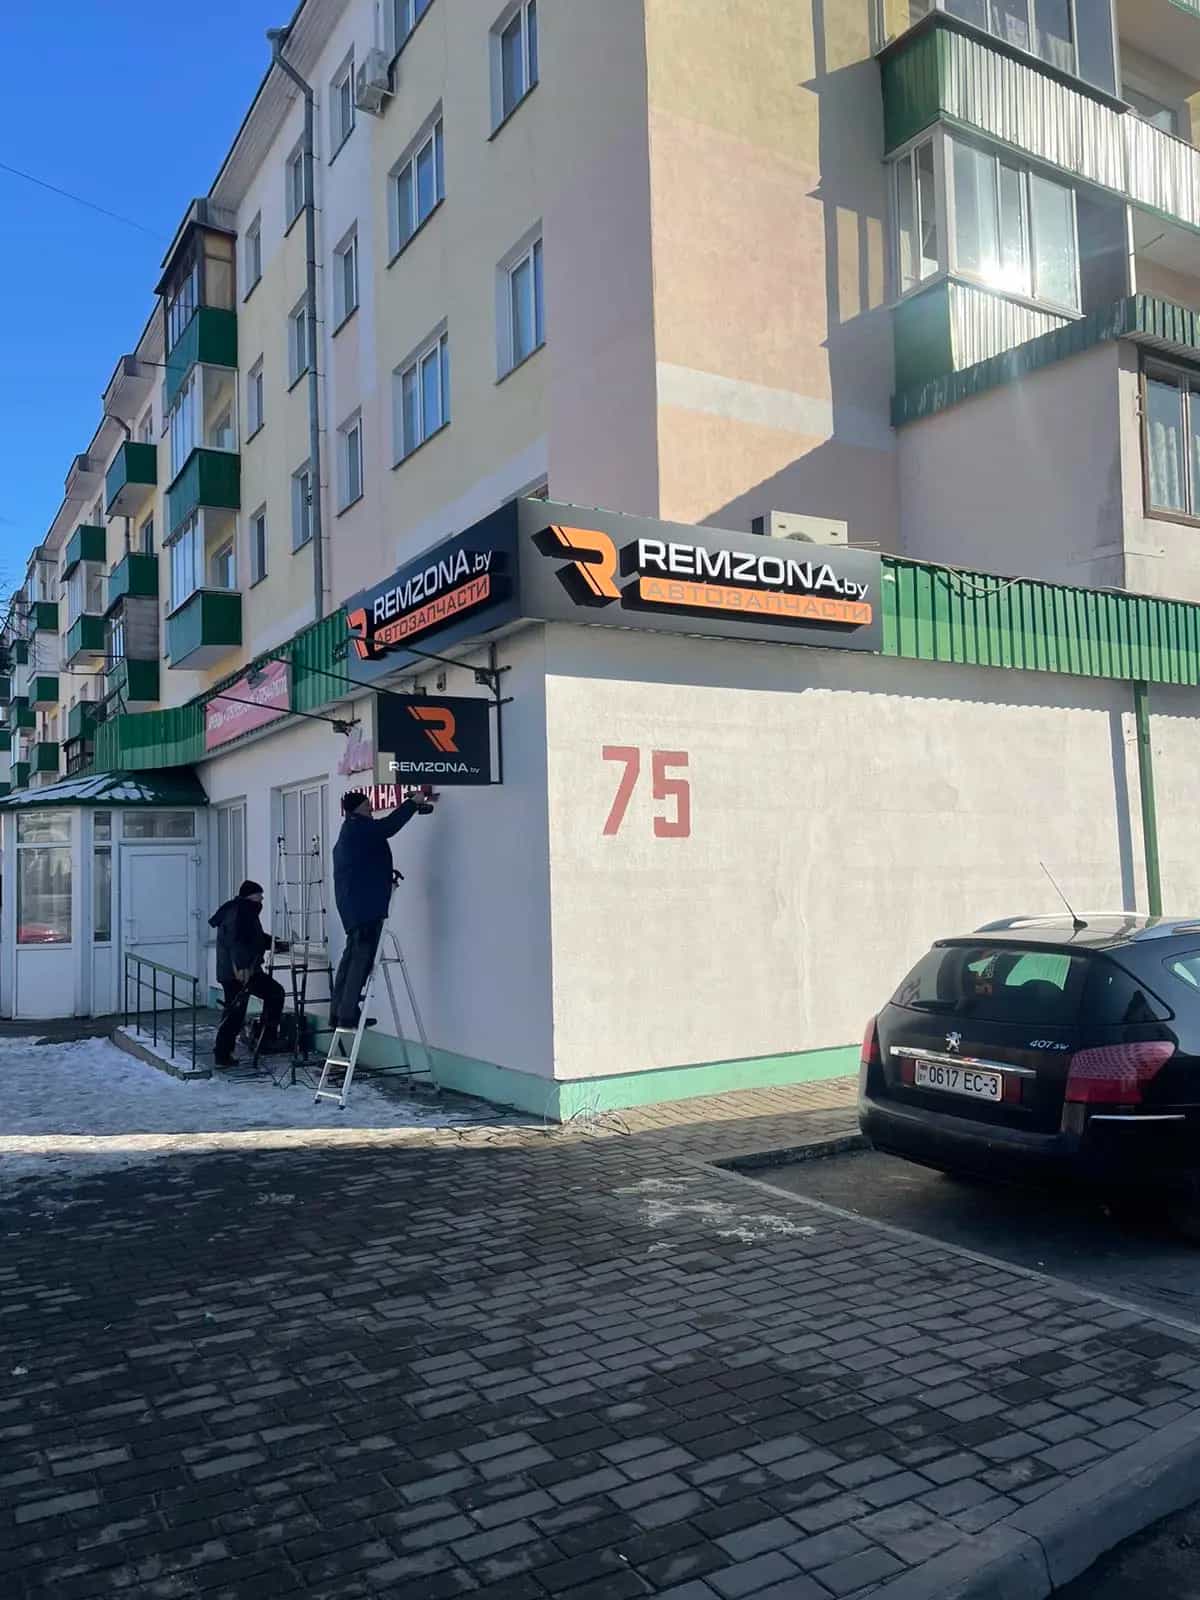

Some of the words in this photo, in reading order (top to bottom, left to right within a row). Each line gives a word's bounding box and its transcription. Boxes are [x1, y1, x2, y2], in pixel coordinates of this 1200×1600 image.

[373, 548, 492, 625] REMZONA.by
[638, 538, 869, 600] REMZONA.by
[377, 578, 488, 643] АВТОЗАПЧАСТИ
[645, 580, 869, 623] АВТОЗАПЧАСТИ
[602, 745, 690, 838] 75
[1029, 1039, 1053, 1048] 407
[929, 1066, 959, 1088] 0617
[963, 1072, 998, 1096] EC-3
